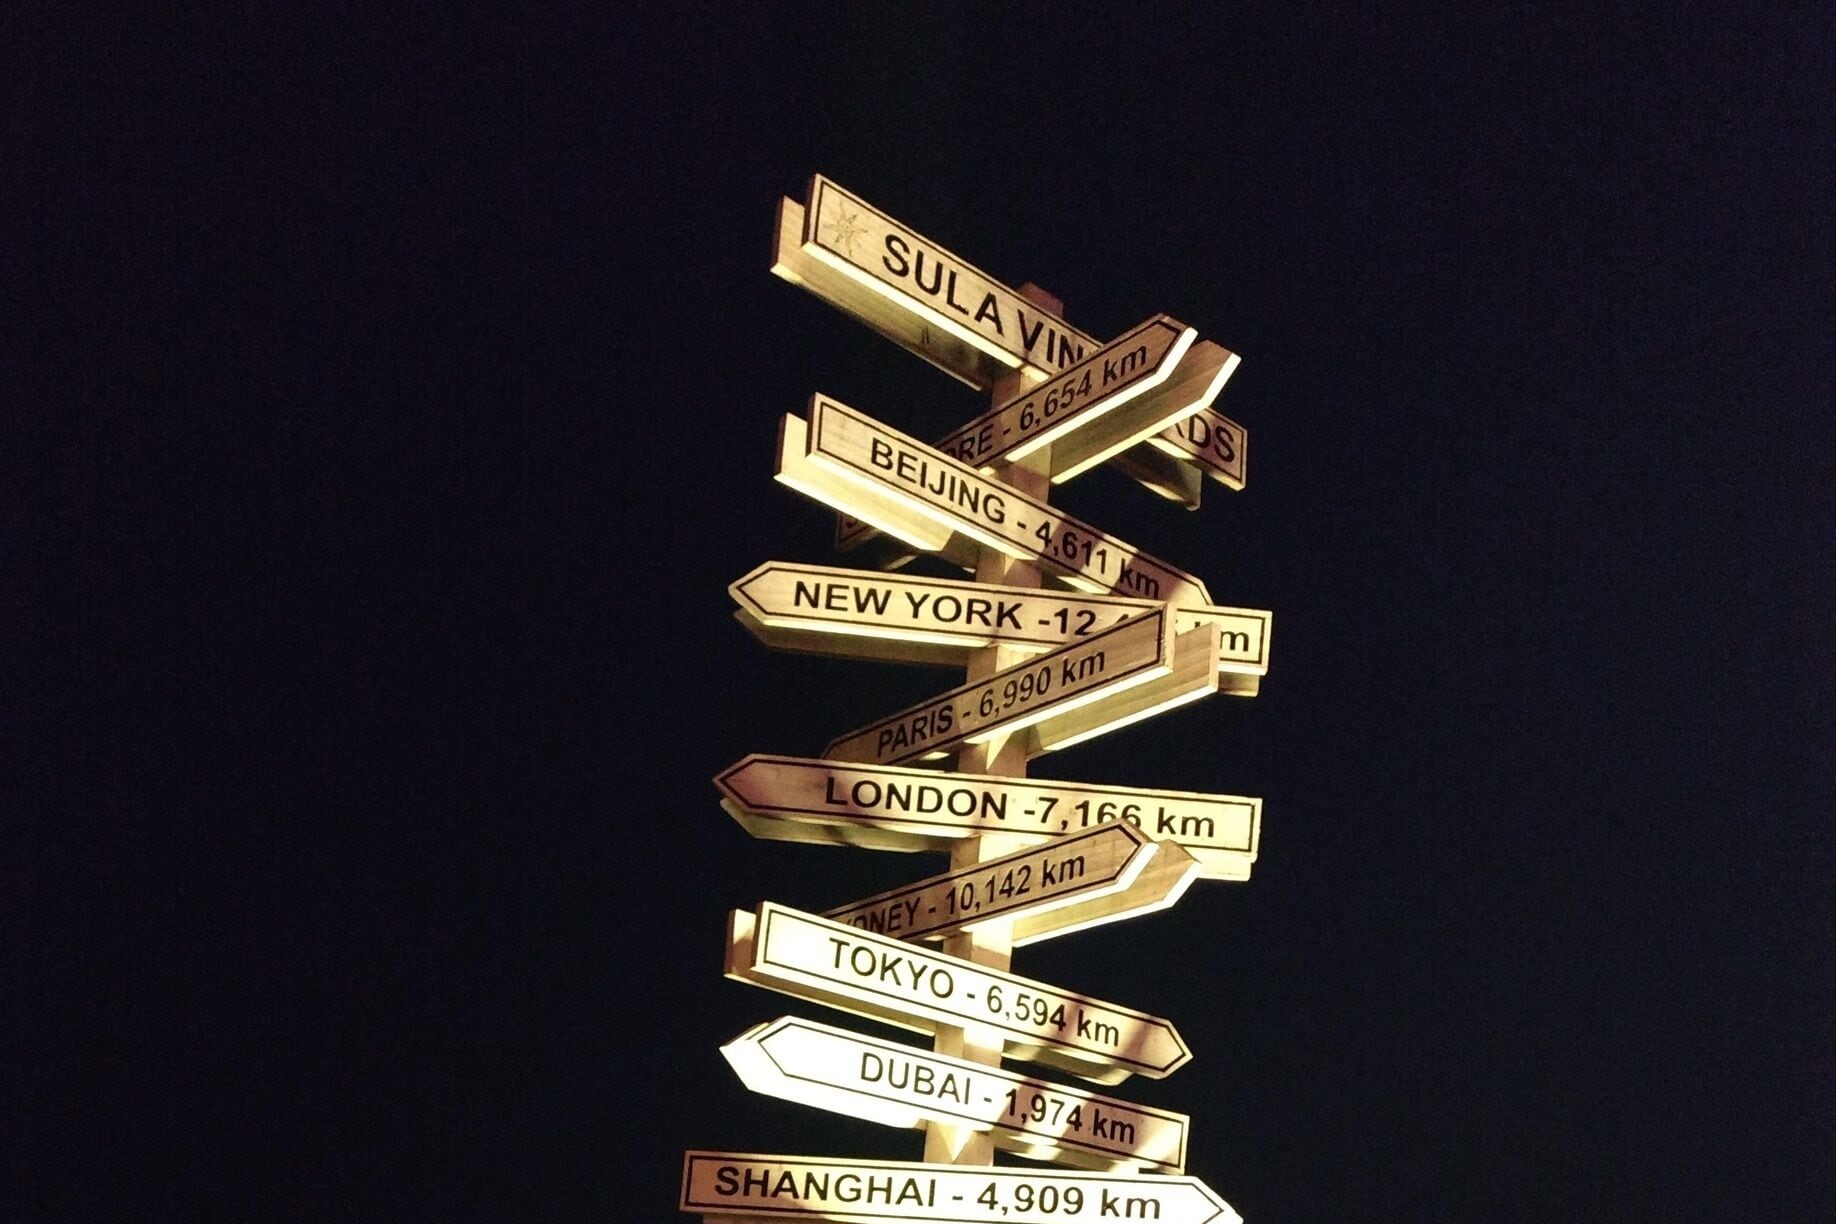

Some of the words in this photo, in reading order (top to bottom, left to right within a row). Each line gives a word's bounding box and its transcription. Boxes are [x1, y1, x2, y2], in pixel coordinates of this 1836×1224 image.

[882, 233, 1004, 336] SULA
[1020, 369, 1092, 430] 6,654
[1102, 346, 1147, 387] km
[871, 437, 1006, 524] BEIJING
[1035, 519, 1108, 575] 4,611
[1120, 564, 1159, 599] km
[793, 580, 892, 615] NEW
[905, 590, 1022, 630] YORK
[877, 704, 953, 757] PARIS
[979, 666, 1051, 717] 6,990
[1061, 651, 1105, 686] km
[826, 777, 1007, 820] LONDON
[1157, 806, 1215, 838] km
[945, 864, 1032, 914] 10,142
[1041, 855, 1085, 888] km
[829, 937, 954, 998] TOKYO
[986, 985, 1067, 1033] 6,594
[1077, 1008, 1120, 1047] km
[860, 1051, 971, 1105] DUBAI
[1005, 1089, 1083, 1132] 1,974
[1092, 1109, 1135, 1145] km
[714, 1166, 936, 1208] SHANGHAI
[976, 1182, 1083, 1217] 4,909
[1100, 1188, 1161, 1220] km
